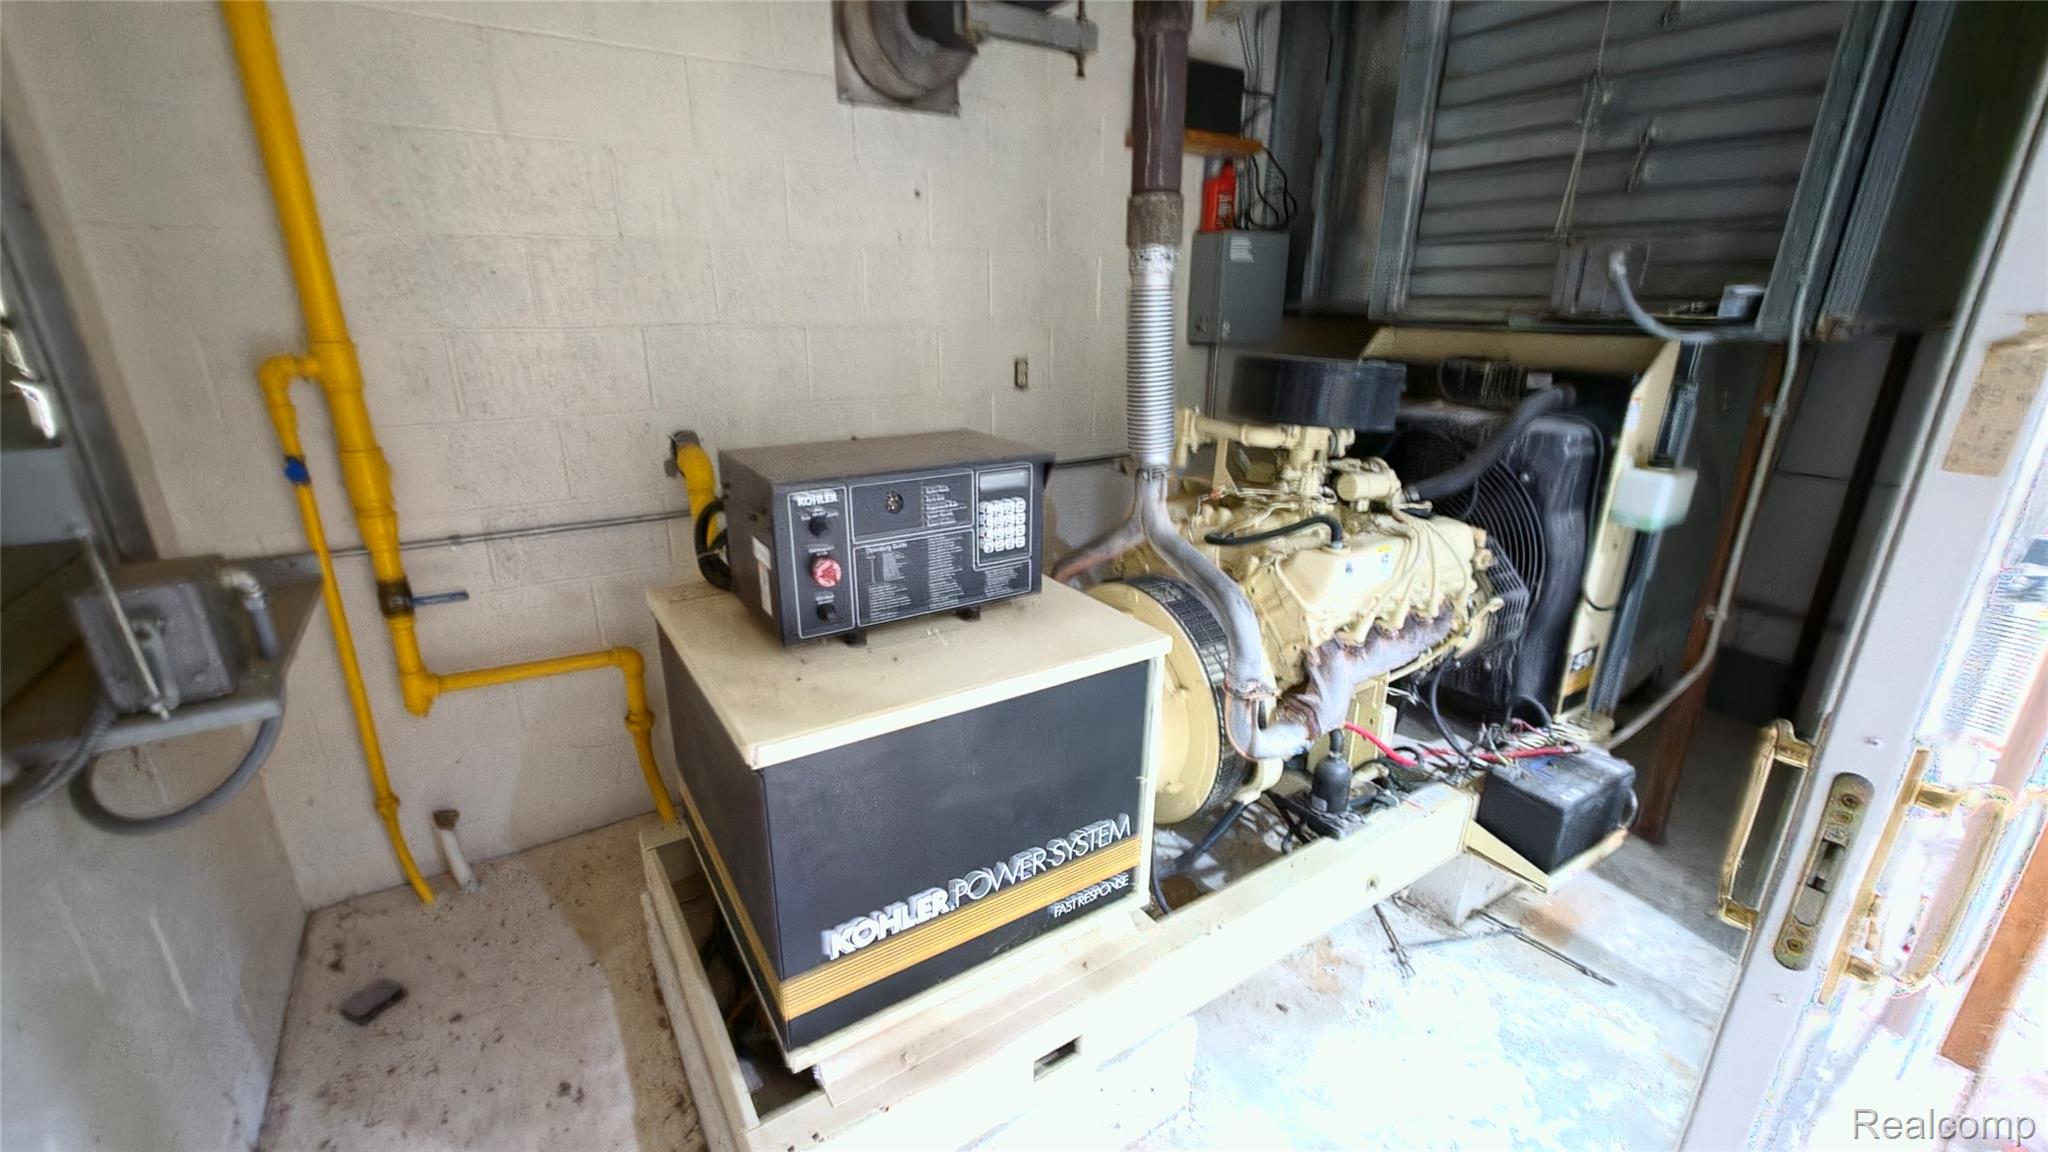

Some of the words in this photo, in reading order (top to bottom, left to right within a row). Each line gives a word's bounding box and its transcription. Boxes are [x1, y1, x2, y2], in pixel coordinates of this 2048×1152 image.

[797, 491, 838, 506] KOHLER
[950, 848, 1047, 907] POWER
[1047, 814, 1131, 866] SYSTEM
[1053, 898, 1078, 918] FAST
[1078, 874, 1129, 906] RESPONSE
